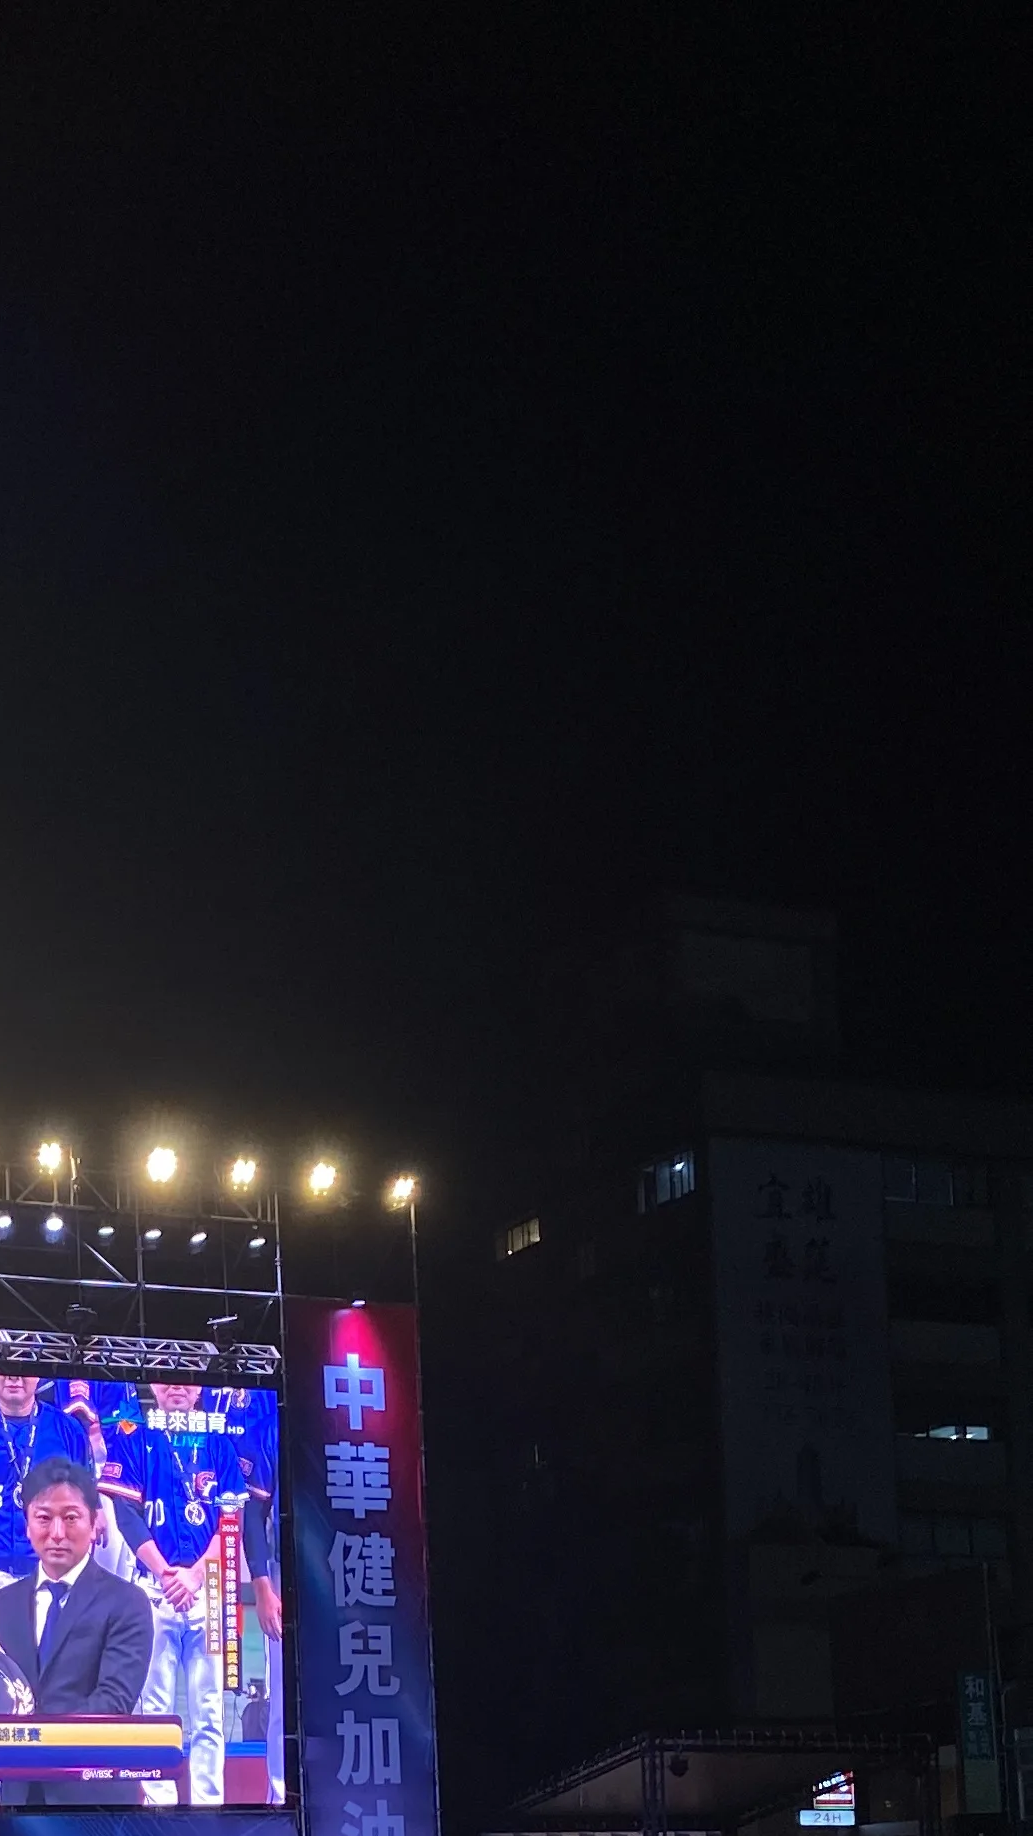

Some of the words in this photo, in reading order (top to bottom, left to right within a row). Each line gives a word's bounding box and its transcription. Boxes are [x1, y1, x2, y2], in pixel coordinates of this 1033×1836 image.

[211, 1387, 233, 1413] 77
[147, 1408, 227, 1433] 緯來體育
[227, 1426, 245, 1435] HD
[172, 1434, 206, 1448] LIVE
[814, 1812, 842, 1823] 24H
